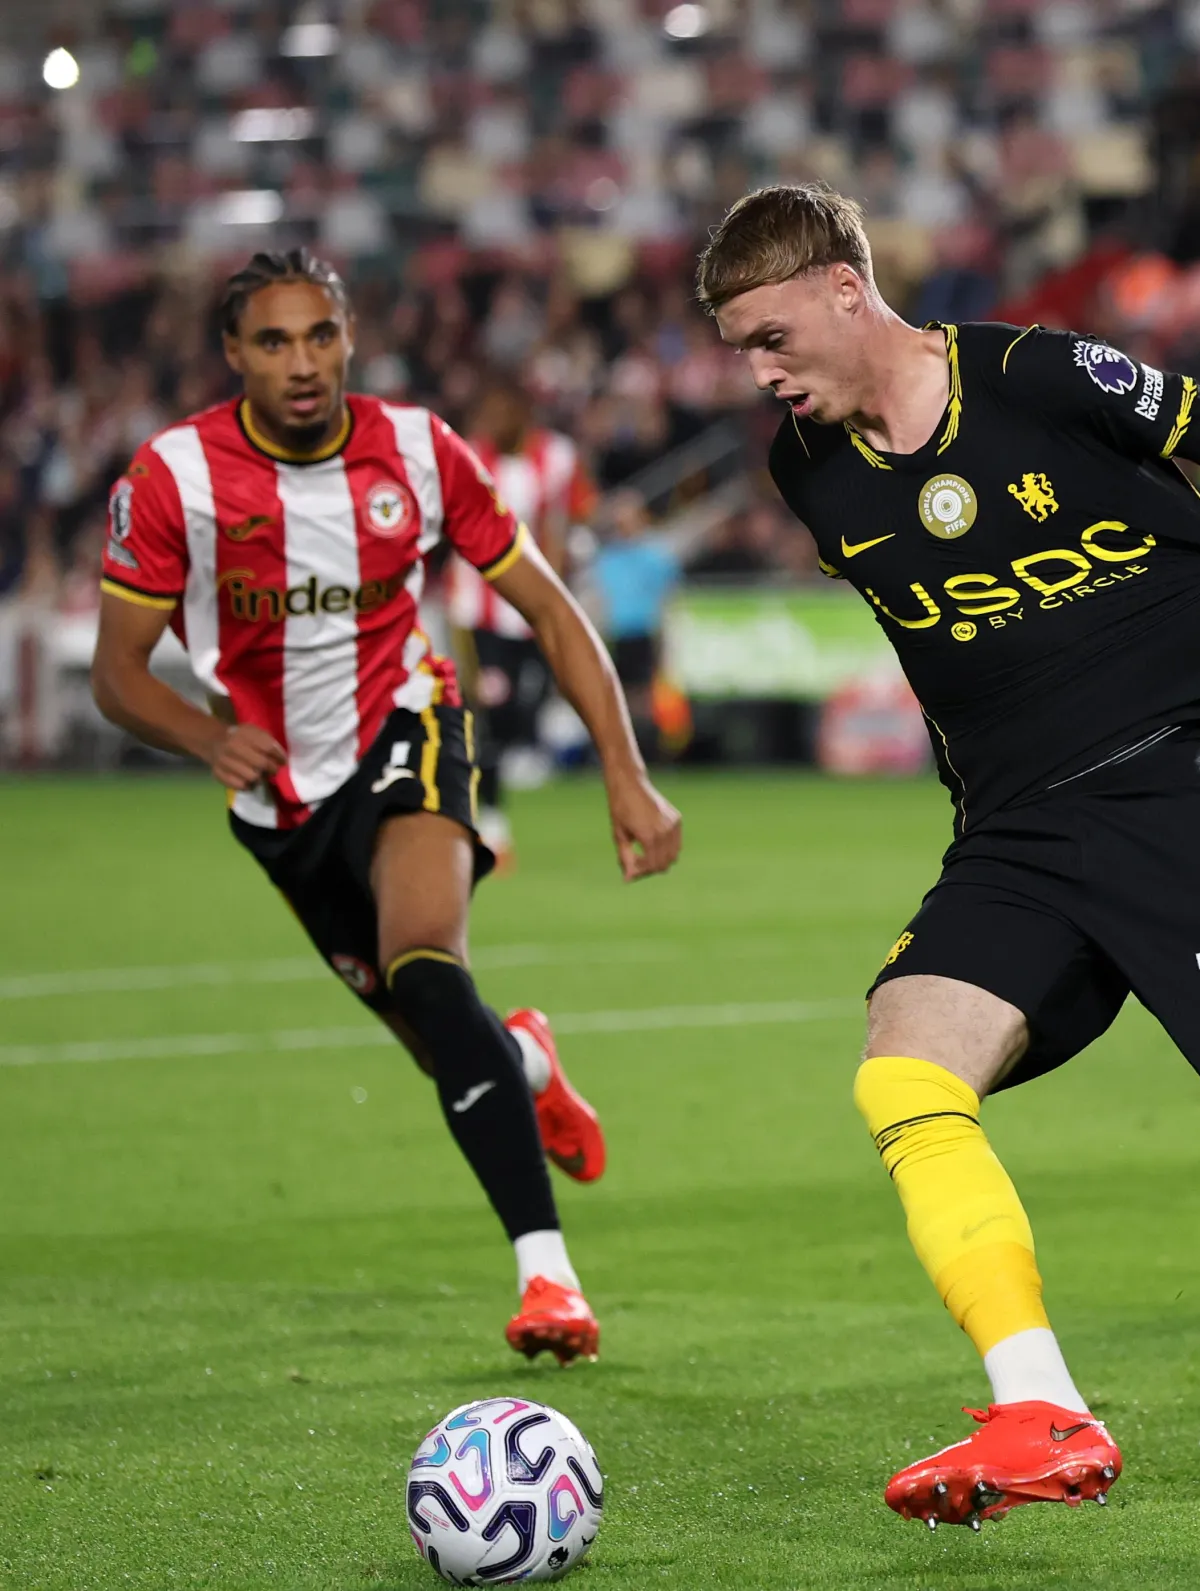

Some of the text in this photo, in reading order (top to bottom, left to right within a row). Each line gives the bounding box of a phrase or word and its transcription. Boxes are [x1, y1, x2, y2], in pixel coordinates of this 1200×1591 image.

[1134, 395, 1150, 417] No
[1145, 399, 1160, 421] for
[923, 479, 972, 523] WORLD CHAMPIONS
[944, 517, 967, 535] FIFA
[217, 568, 398, 622] indee
[865, 520, 1156, 629] USDC
[988, 564, 1148, 629] BY CIRCLE
